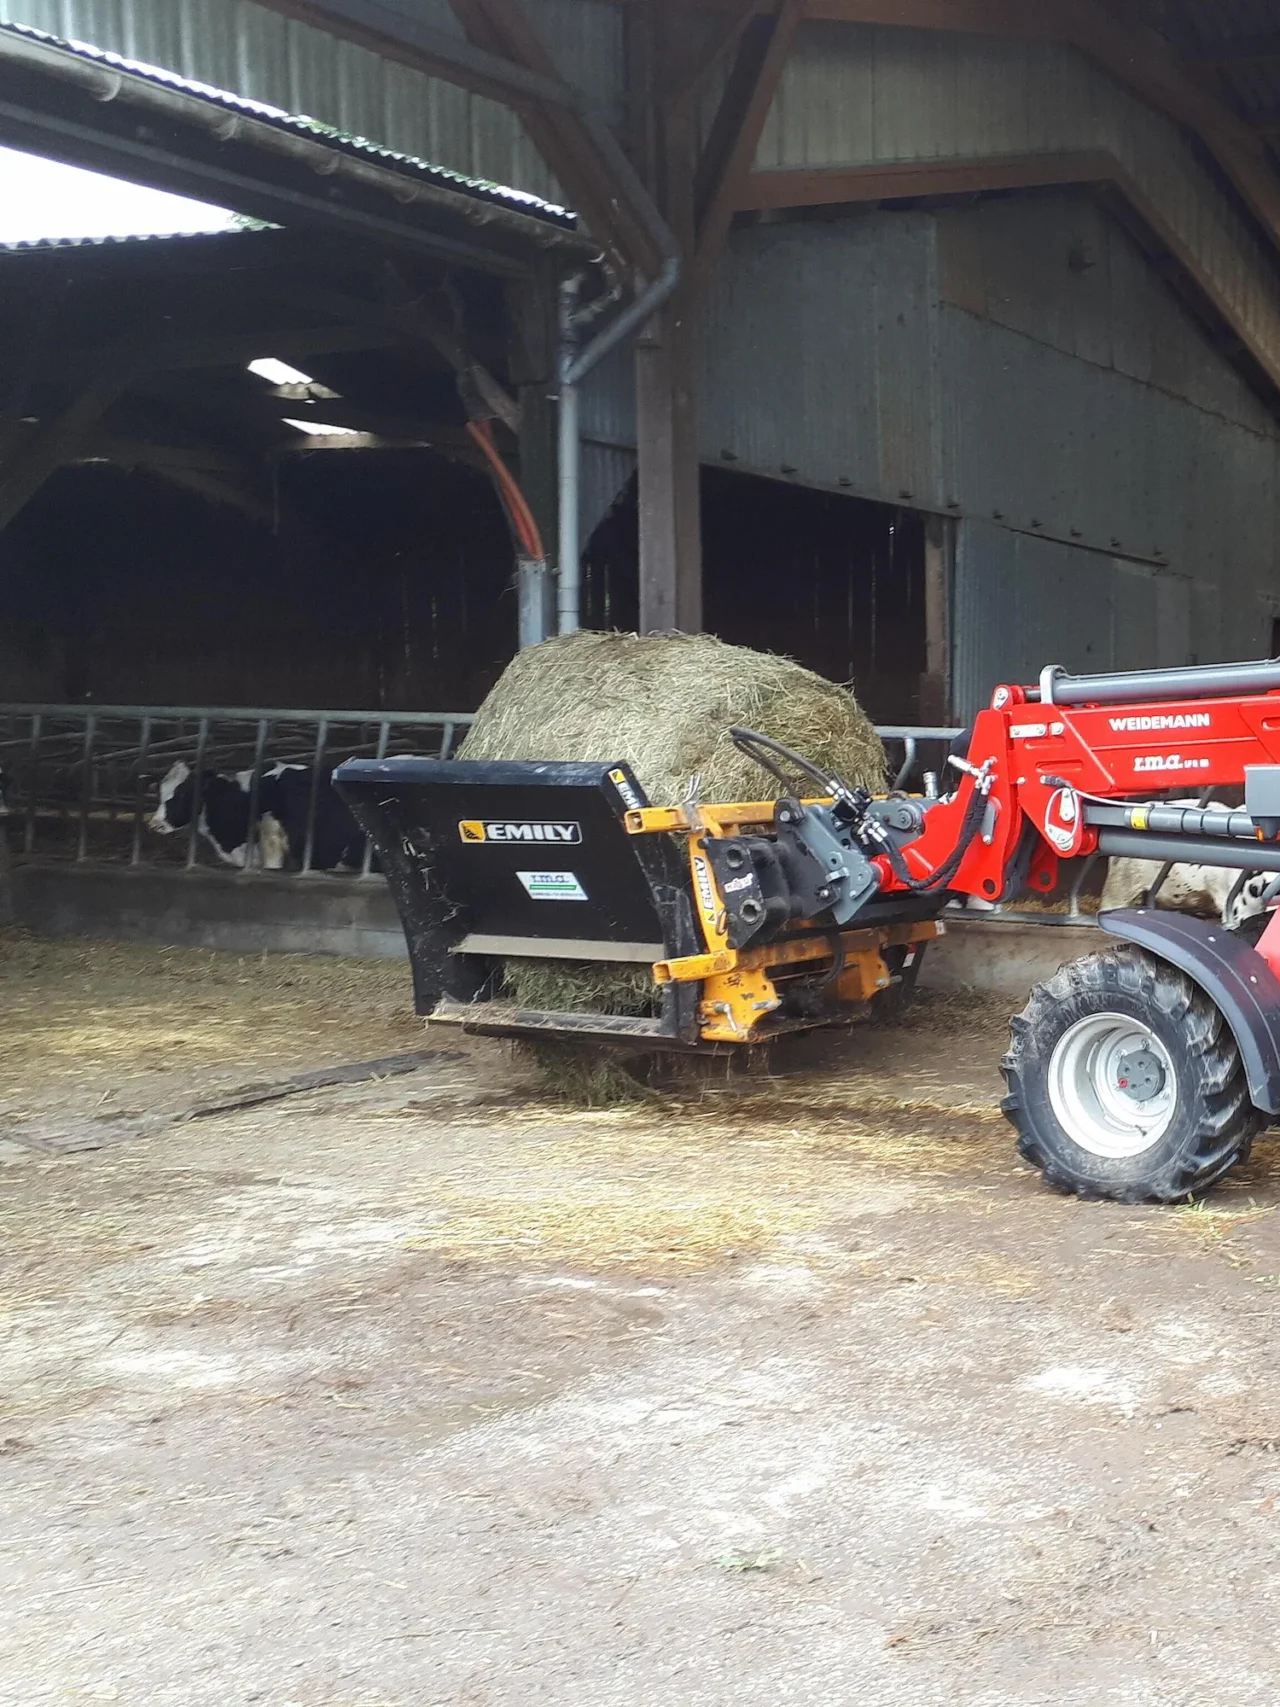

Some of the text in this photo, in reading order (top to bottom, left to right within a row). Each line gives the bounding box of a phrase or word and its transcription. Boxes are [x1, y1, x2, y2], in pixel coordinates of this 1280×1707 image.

[1109, 713, 1210, 731] WEIDEMANN
[617, 781, 640, 809] EMI
[486, 824, 574, 840] EMILY
[694, 857, 714, 910] EMILY
